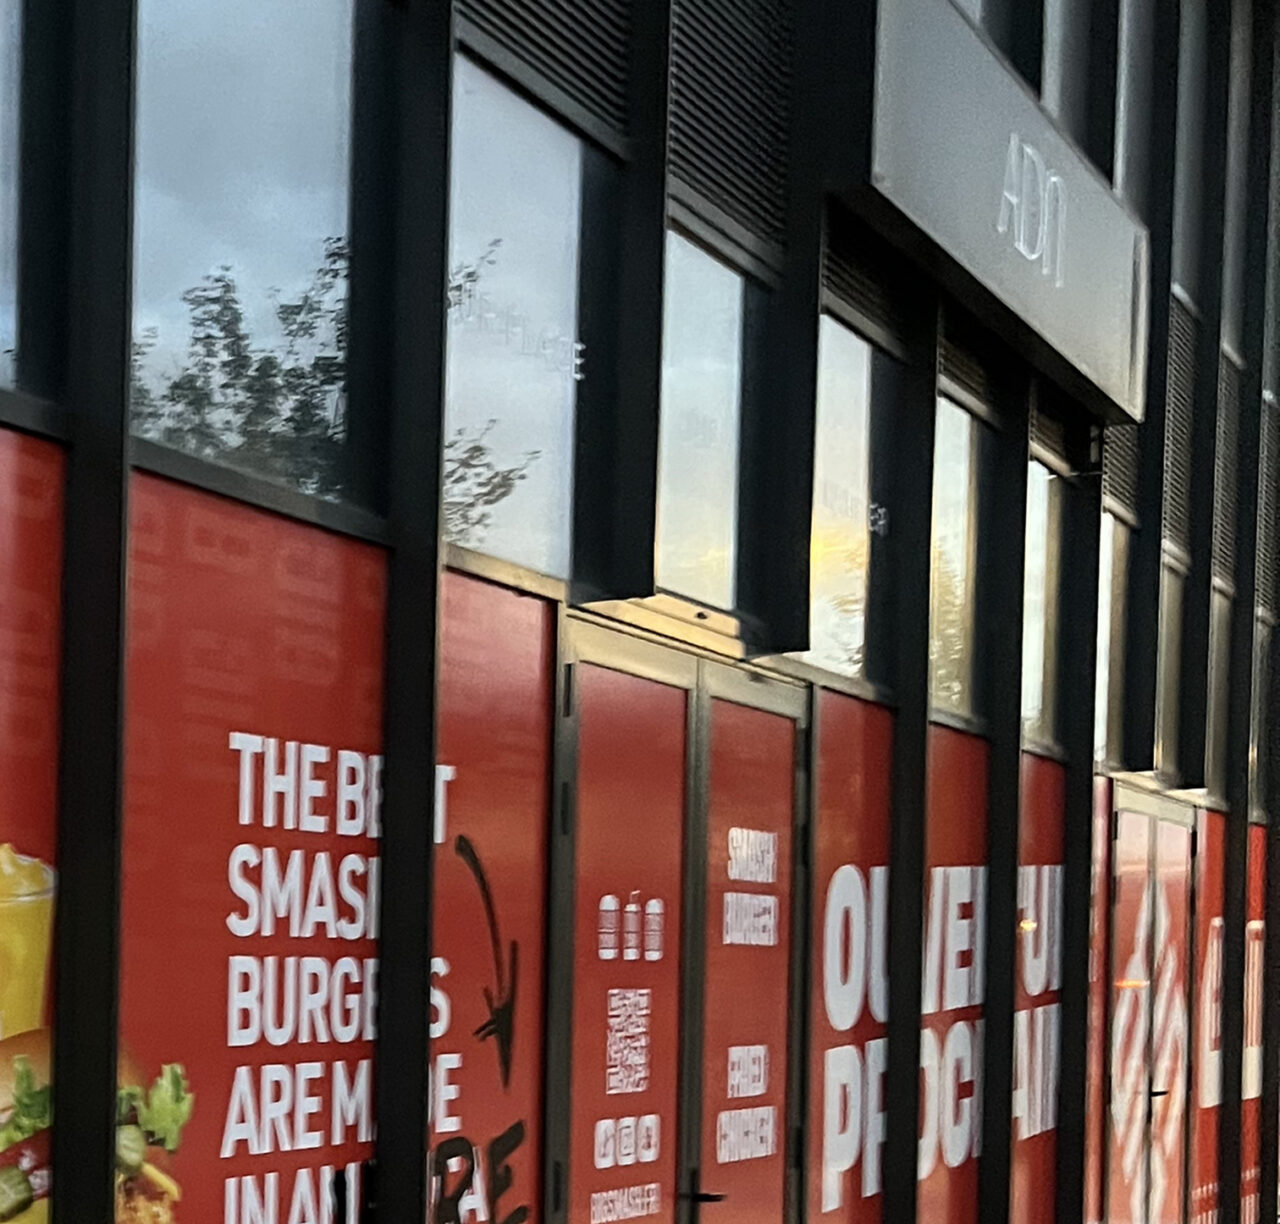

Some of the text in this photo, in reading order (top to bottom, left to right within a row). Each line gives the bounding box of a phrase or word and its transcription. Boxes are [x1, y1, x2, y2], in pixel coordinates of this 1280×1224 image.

[228, 731, 457, 845] THE BET
[226, 955, 451, 1047] BURGES
[220, 1053, 463, 1159] ARE ME
